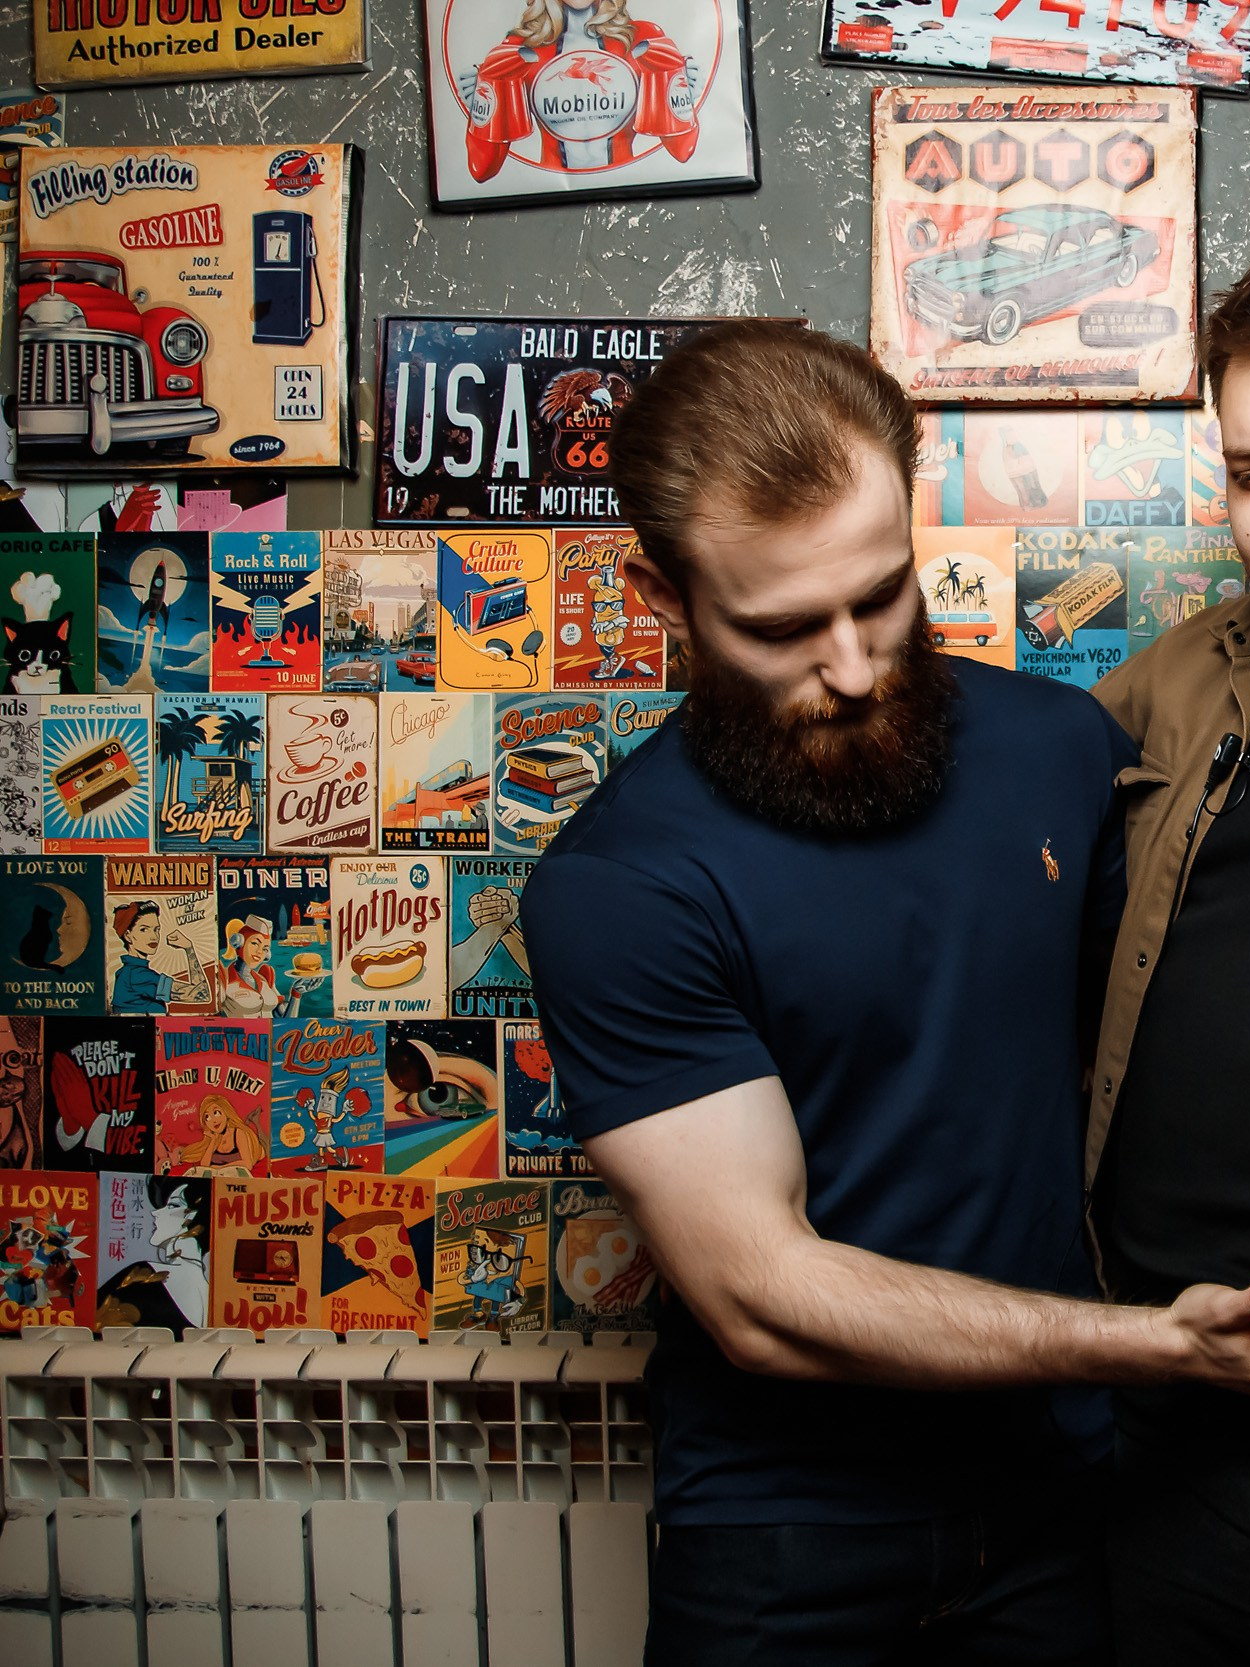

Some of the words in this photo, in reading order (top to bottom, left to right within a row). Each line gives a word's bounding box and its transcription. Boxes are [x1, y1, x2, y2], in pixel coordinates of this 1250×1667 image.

[68, 31, 218, 65] Authorized
[235, 27, 324, 51] Dealer
[543, 92, 625, 115] Mobiloil
[906, 95, 963, 120] Tous
[966, 96, 1009, 119] les
[1012, 95, 1162, 120] Accessoires
[26, 123, 51, 138] CLUB
[905, 140, 1149, 183] AUTO
[31, 164, 107, 217] Filling
[113, 156, 193, 193] station
[121, 208, 221, 248] GASOLINE
[179, 270, 234, 282] Guaranteed
[187, 286, 223, 299] Quality
[284, 370, 312, 382] OPEN
[287, 387, 308, 399] 24
[281, 404, 316, 417] HOURS
[394, 363, 530, 478] USA
[567, 442, 609, 468] 66
[386, 487, 408, 513] 19
[488, 486, 526, 515] THE
[540, 487, 620, 516] MOTHER
[1087, 501, 1183, 525] DAFFY
[49, 540, 94, 552] CAFE
[328, 532, 364, 548] LAS
[372, 531, 436, 548] VEGAS
[469, 540, 518, 558] Crush
[1017, 531, 1121, 551] KODAK
[225, 555, 259, 569] Rock
[264, 555, 274, 567] &
[279, 554, 307, 568] Roll
[462, 553, 524, 574] Culture
[558, 546, 619, 581] Party
[1017, 553, 1081, 571] FILM
[238, 574, 259, 584] Live
[263, 574, 294, 584] Music
[559, 593, 584, 605] LIFE
[1068, 589, 1098, 614] KODAK
[1098, 575, 1116, 594] FILM
[1022, 652, 1086, 664] VERICHROME
[1087, 648, 1122, 663] V620
[50, 704, 86, 715] Retro
[89, 704, 141, 715] Festival
[500, 702, 601, 748] Science
[569, 731, 595, 747] CLUB
[513, 759, 538, 772] PHYSICS
[277, 776, 370, 827] Coffee
[165, 802, 252, 844] Surfing
[386, 832, 411, 843] THE
[436, 832, 487, 843] TRAIN
[111, 862, 209, 887] WARNING
[219, 868, 328, 889] DINER
[166, 890, 208, 910] WOMAN
[177, 910, 205, 926] WORK
[4, 981, 20, 994] TO
[22, 981, 52, 994] THE
[55, 981, 95, 994] MOON
[16, 998, 41, 1009] AND
[45, 998, 79, 1009] BACK
[349, 1000, 375, 1012] BEST
[378, 1000, 390, 1012] IN
[393, 999, 431, 1012] TOWN!
[304, 1019, 344, 1038] Cheer
[71, 1040, 118, 1064] PLEASE
[163, 1032, 209, 1061] VIDEO
[274, 1027, 377, 1075] Leader
[85, 1051, 135, 1077] DON'T
[91, 1071, 140, 1112] KILL
[509, 1155, 562, 1174] PRIVATE
[226, 1184, 247, 1192] THE
[12, 1186, 89, 1210] LOVE
[218, 1184, 320, 1229] MUSIC
[441, 1190, 541, 1231] Science
[519, 1213, 542, 1226] CLUB
[440, 1263, 460, 1274] WED
[332, 1298, 348, 1309] FOR
